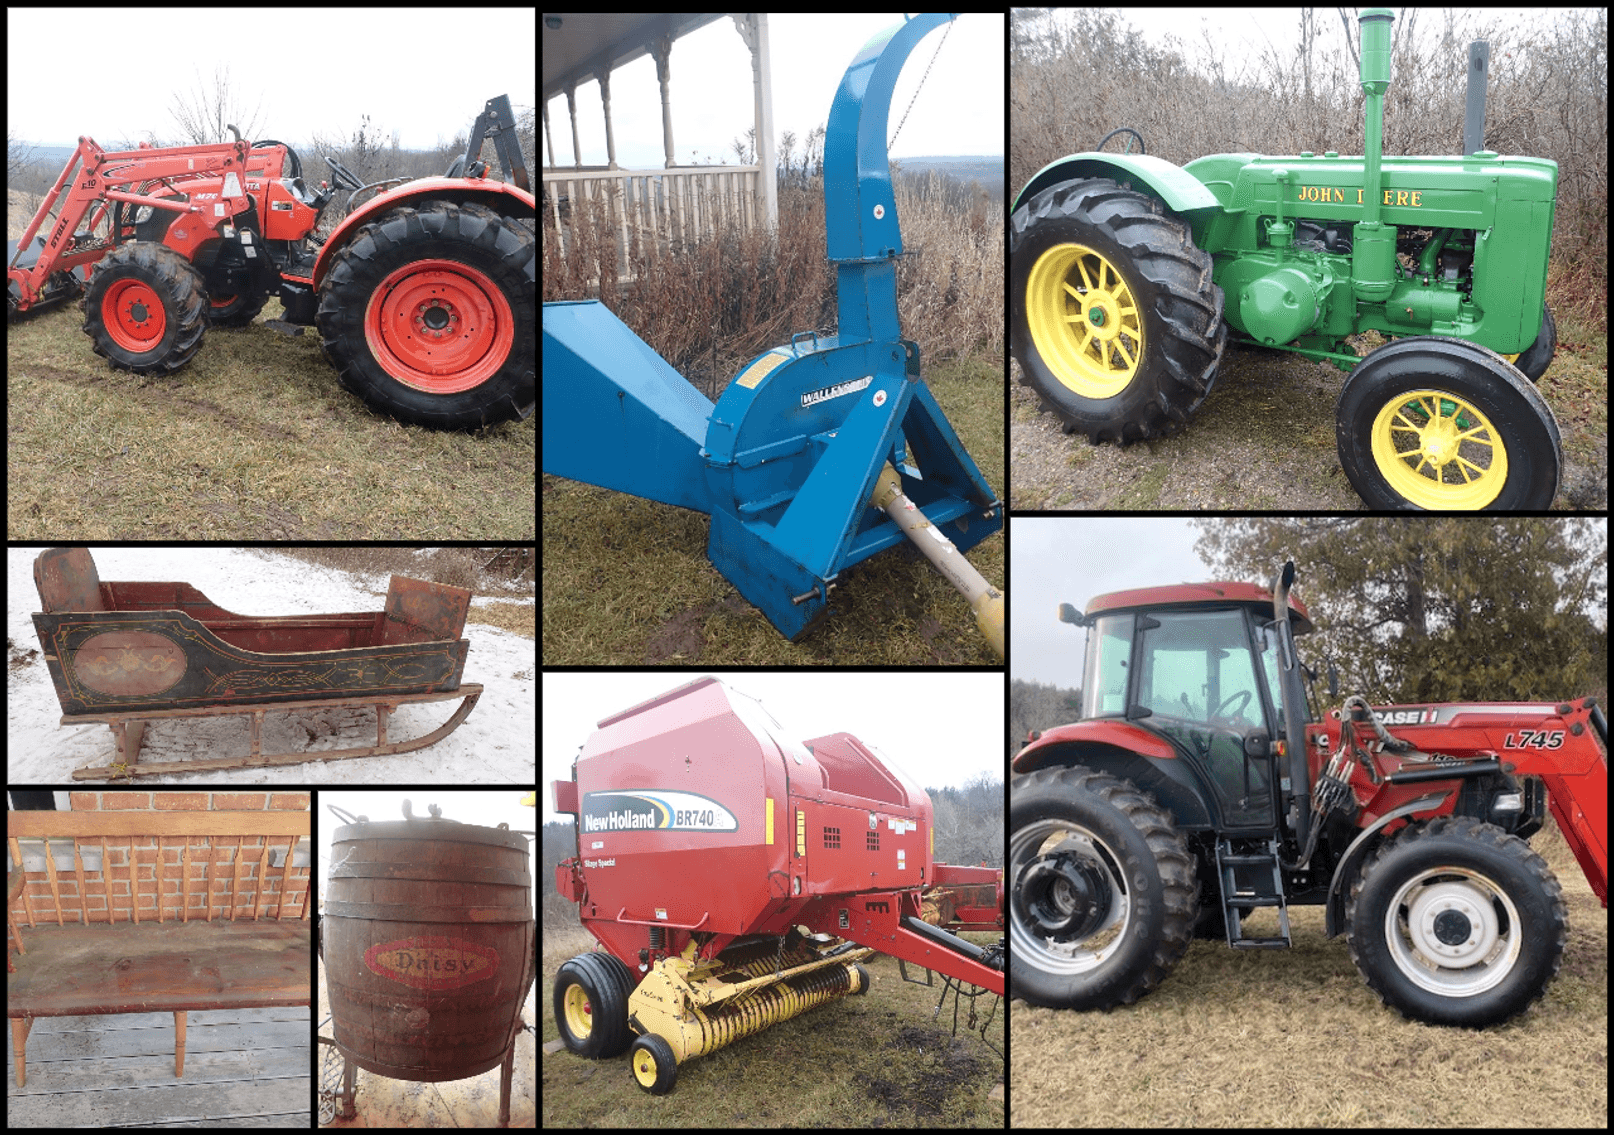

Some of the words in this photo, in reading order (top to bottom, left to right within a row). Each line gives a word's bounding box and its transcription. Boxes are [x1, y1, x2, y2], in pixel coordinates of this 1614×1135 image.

[1298, 186, 1344, 202] JOHN
[1356, 189, 1423, 207] DERE
[585, 814, 608, 832] New
[609, 808, 655, 830] Holland
[395, 951, 476, 975] Daisy
